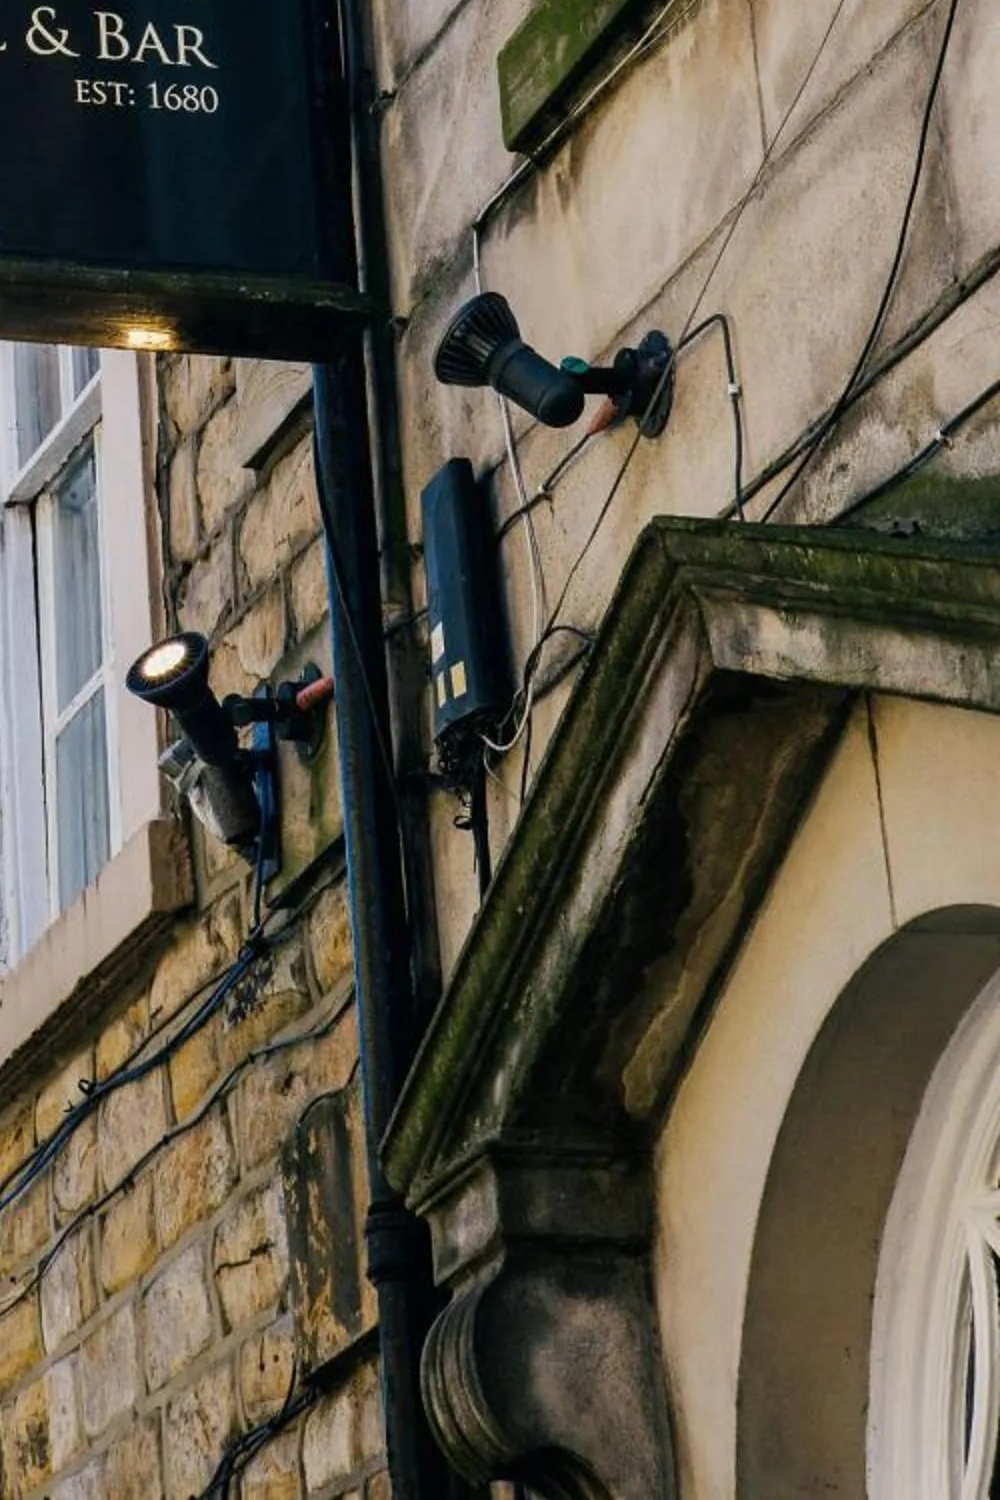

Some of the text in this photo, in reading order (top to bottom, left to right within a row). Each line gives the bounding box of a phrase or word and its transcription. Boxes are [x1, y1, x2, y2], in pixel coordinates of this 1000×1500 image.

[25, 6, 81, 58] &
[93, 11, 219, 69] BAR
[74, 79, 219, 113] EST: 1680
